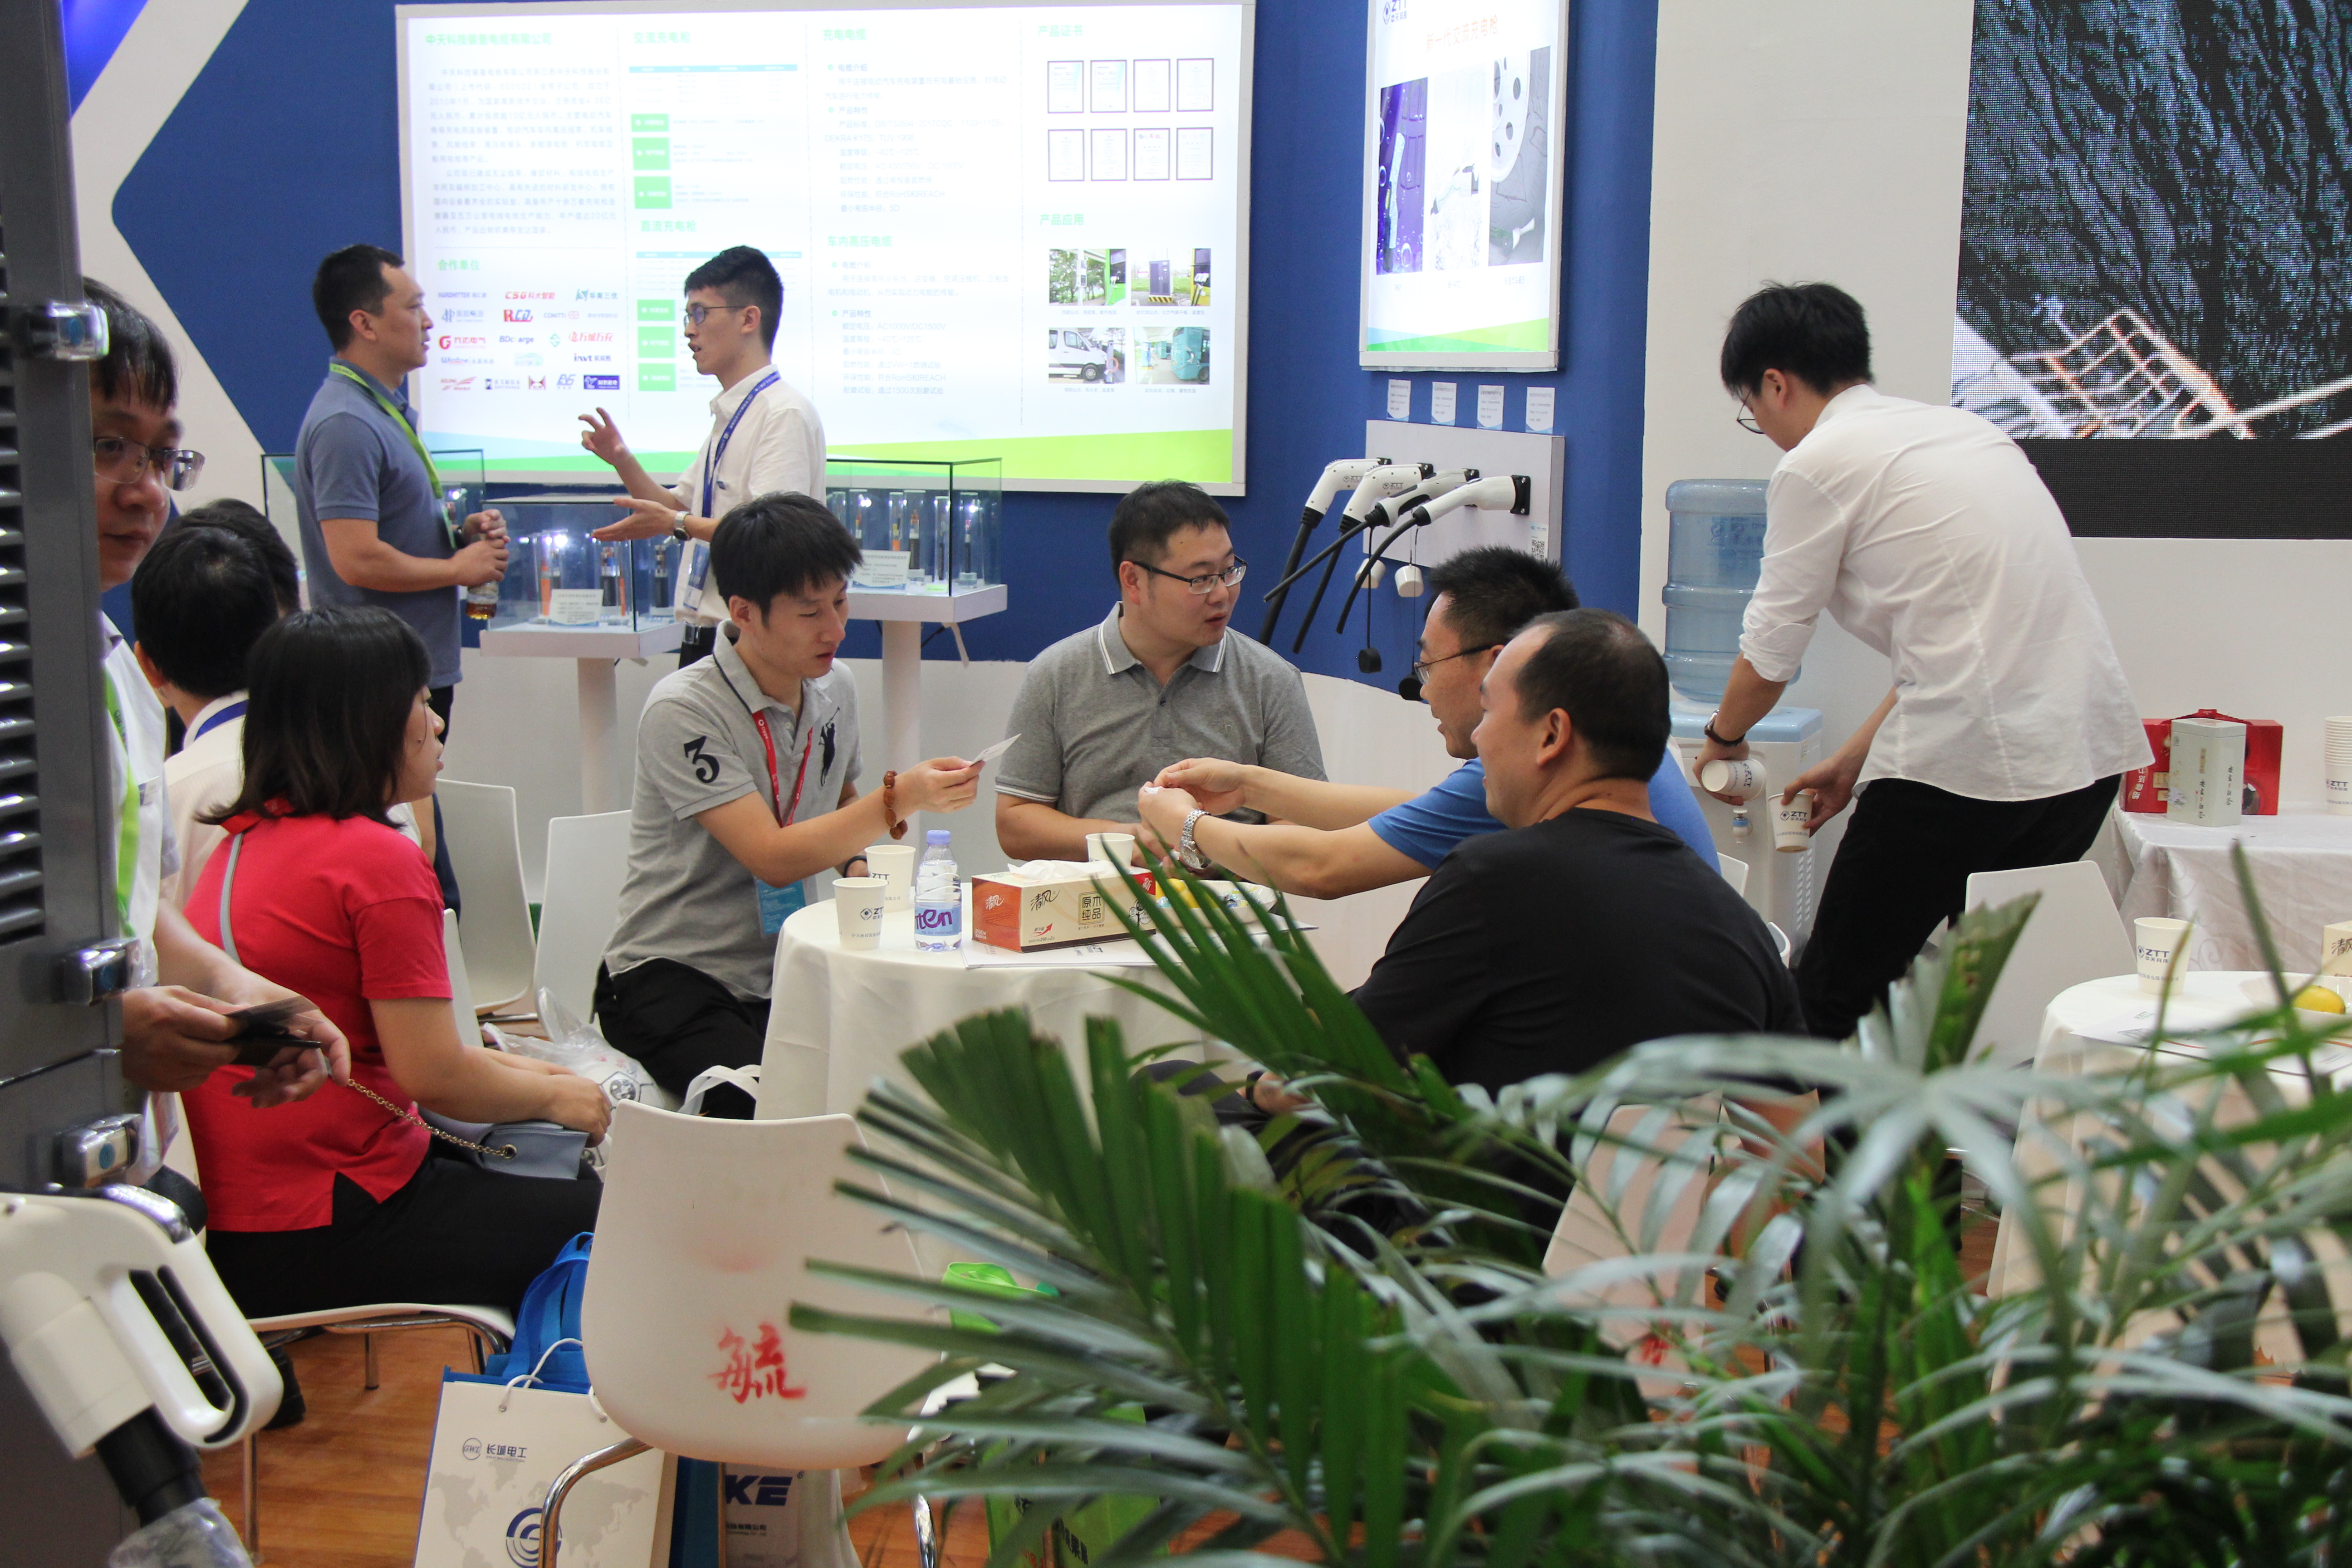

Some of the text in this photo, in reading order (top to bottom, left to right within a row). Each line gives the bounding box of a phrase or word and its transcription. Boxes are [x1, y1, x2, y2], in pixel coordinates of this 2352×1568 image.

[823, 28, 867, 41] 充电电缆
[1038, 25, 1083, 37] 产品证书
[1426, 14, 1498, 52] 新一代交流充电枪
[425, 33, 551, 45] 中天科技装备电缆有限公司
[634, 31, 691, 44] 交流充电枪
[1040, 213, 1084, 225] 产品应用
[641, 220, 697, 232] 直流充电枪
[828, 235, 892, 247] 车内高压电缆
[437, 259, 480, 271] 合作单位
[842, 309, 872, 318] 产品特性
[684, 735, 720, 784] 3
[986, 894, 1005, 910] 清风
[1030, 889, 1061, 911] 清风
[1082, 896, 1102, 908] 原木
[874, 906, 884, 915] ZT
[1082, 908, 1101, 921] 纯品
[2146, 948, 2170, 958] ZTT
[486, 1443, 527, 1459] 长城电工
